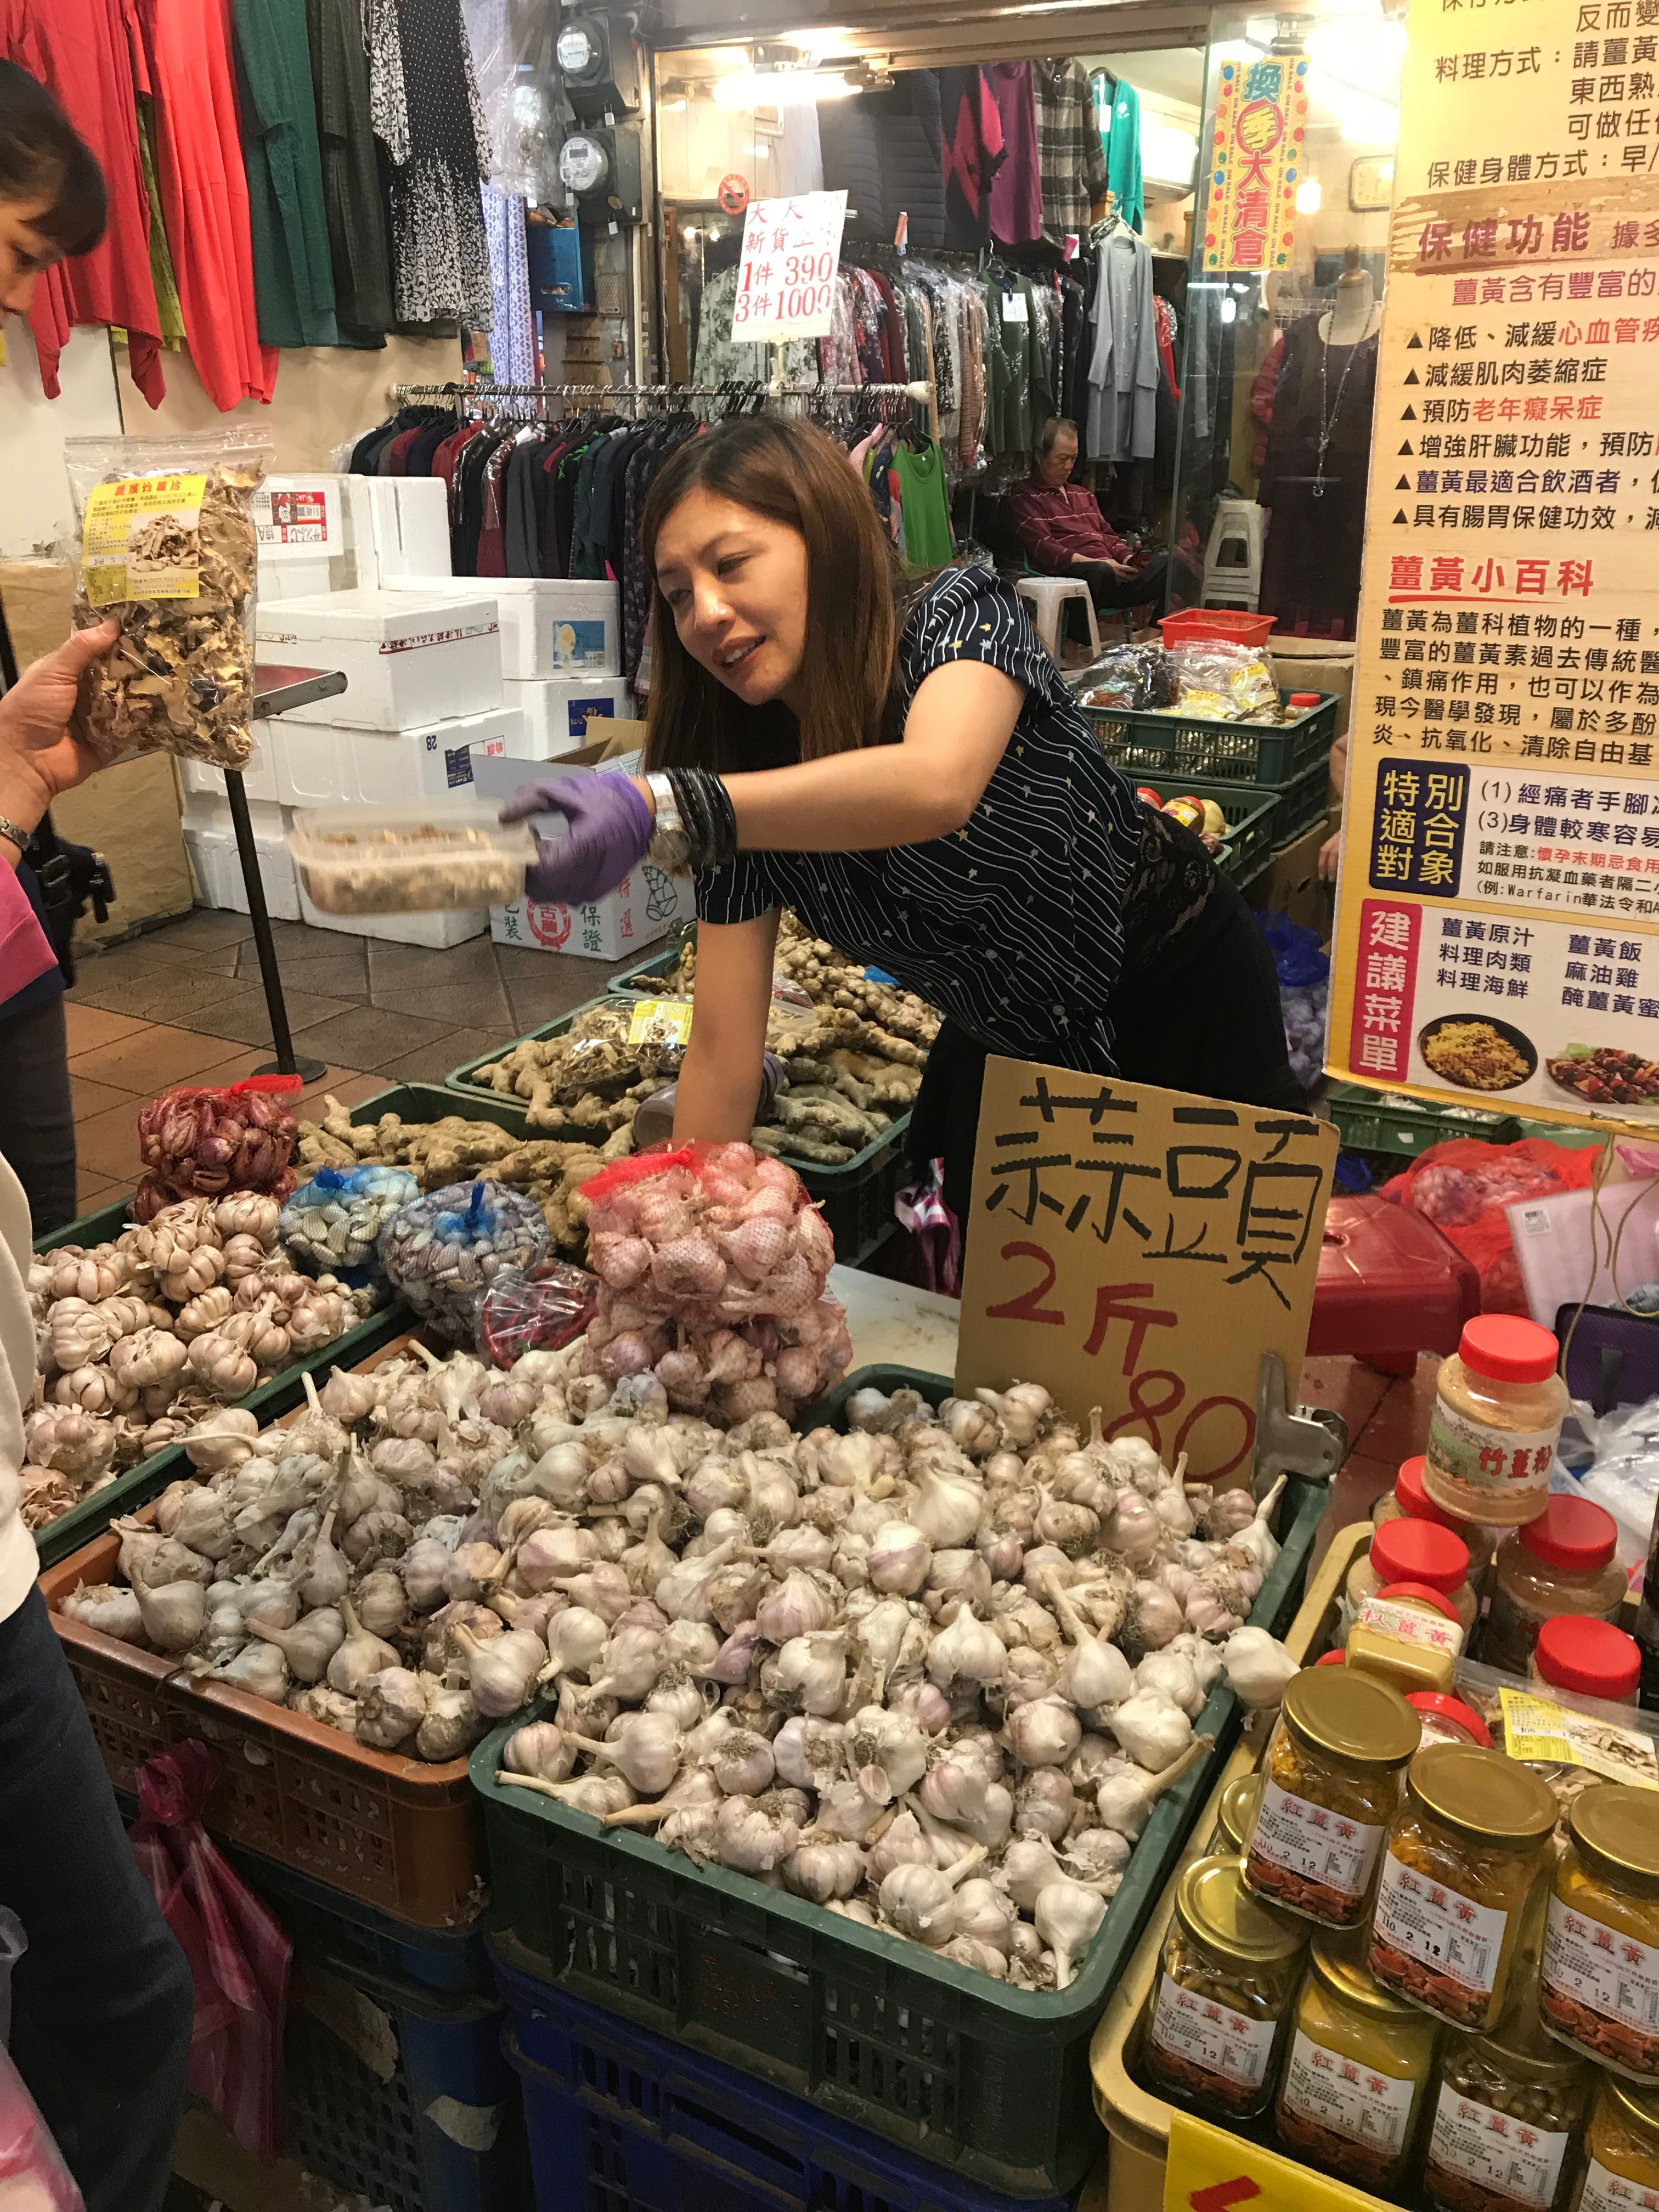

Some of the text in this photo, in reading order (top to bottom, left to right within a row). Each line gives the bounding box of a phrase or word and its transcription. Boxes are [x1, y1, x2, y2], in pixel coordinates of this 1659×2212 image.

[1570, 72, 1659, 105] 東西熟
[1568, 108, 1659, 140] 可做任
[1230, 62, 1283, 266] 換季大清倉
[1419, 211, 1590, 262] 保健功能
[1452, 268, 1659, 307] 薑黃含有豐富的
[1425, 357, 1609, 387] 減緩肌肉萎縮症
[1423, 395, 1604, 424] 預防老年癡呆症
[1419, 431, 1659, 459] 增強肝臟功能，預防
[1389, 555, 1594, 597] 薑黃小百科
[426, 735, 437, 751] 28
[580, 905, 603, 952] 保證
[1442, 917, 1643, 963] 薑黃原汁 薑黃飯
[1436, 968, 1529, 999] 料理海鮮
[1439, 943, 1639, 989] 料理肉類 麻油雞
[1359, 911, 1410, 1072] 建議菜單
[985, 1077, 1323, 1312] 蒜頭
[1103, 1369, 1257, 1482] 80
[1479, 1445, 1553, 1479] 竹薑粉
